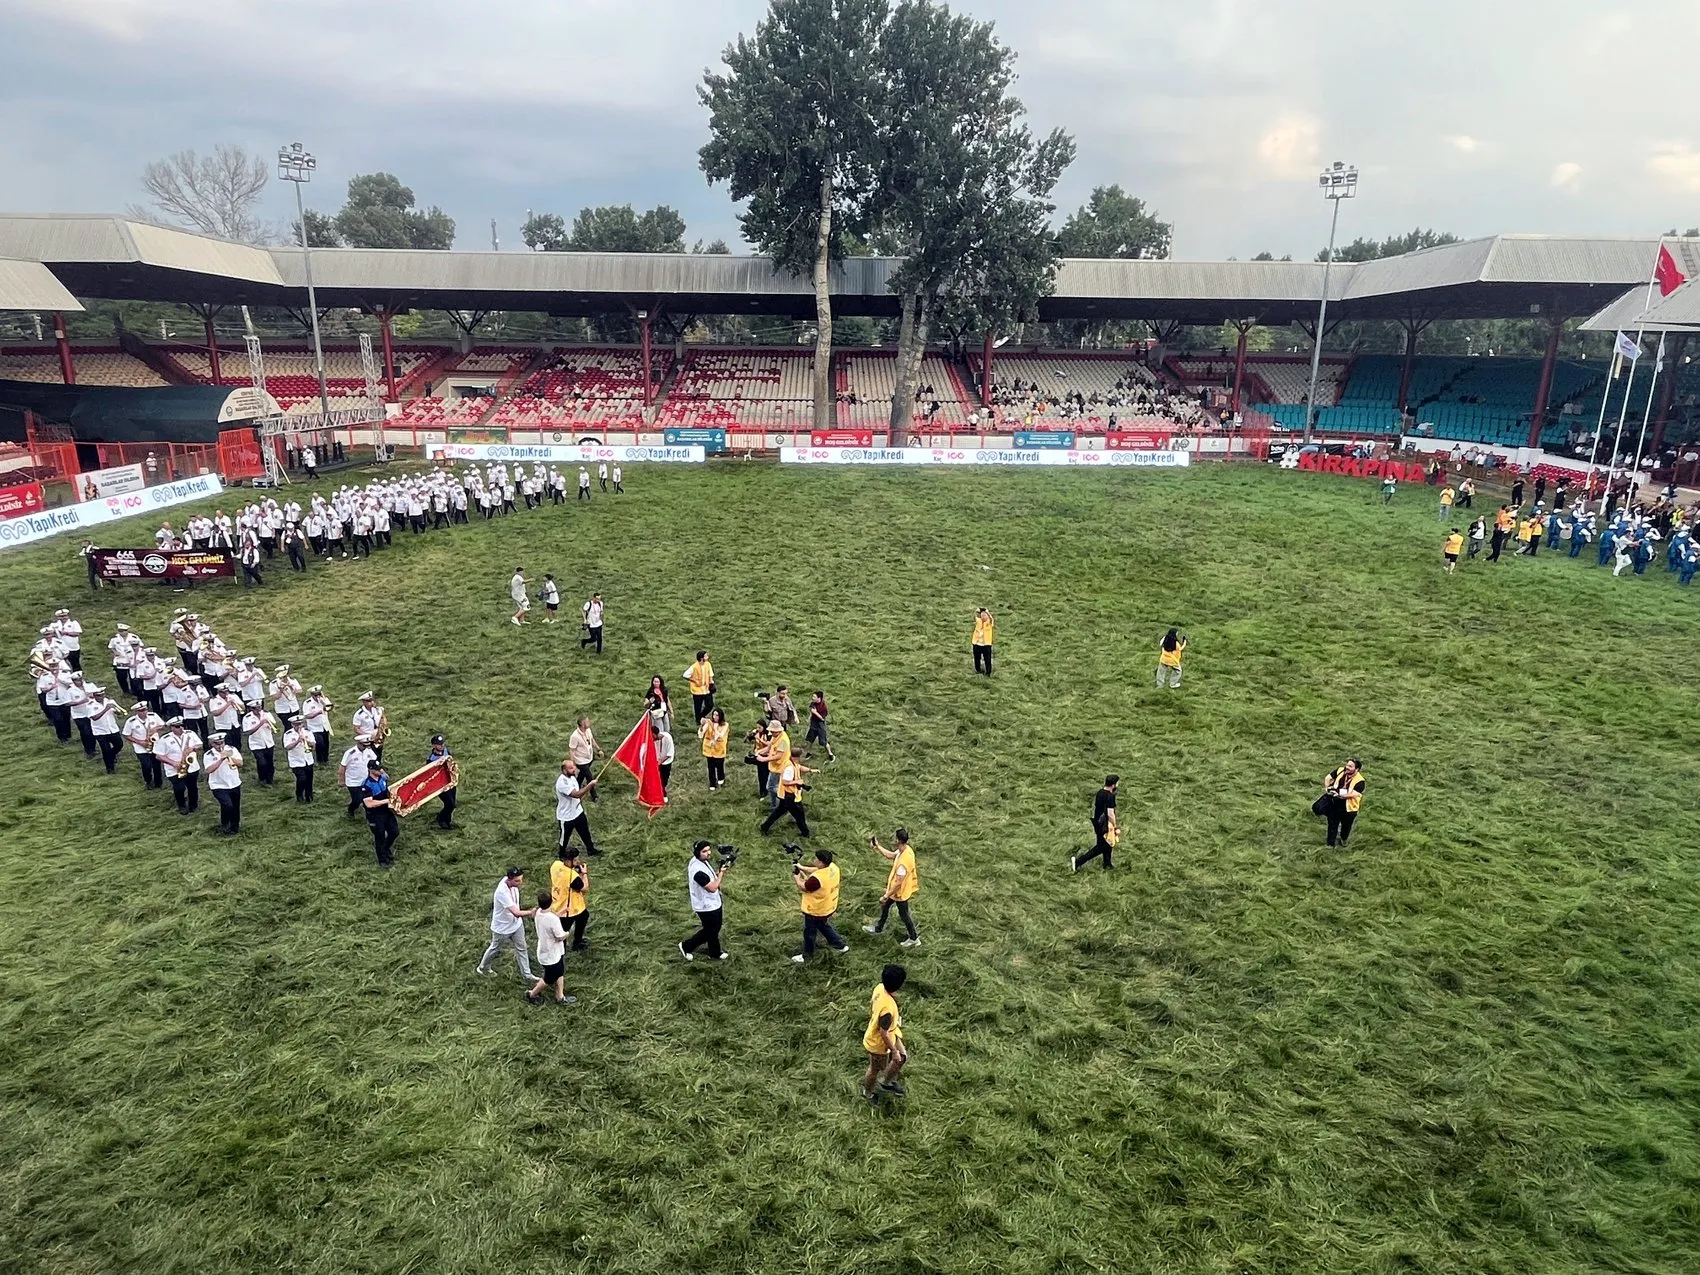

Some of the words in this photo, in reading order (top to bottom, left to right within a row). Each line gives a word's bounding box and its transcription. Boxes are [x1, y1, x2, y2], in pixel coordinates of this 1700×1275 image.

[510, 446, 552, 458] YapıKredi
[648, 448, 690, 458] YapıKredi
[863, 450, 904, 460] YapıKredi
[998, 452, 1039, 462] YapıKredi
[1134, 453, 1174, 463] YapıKredi
[170, 479, 209, 497] YapıKredi
[26, 508, 80, 532] YapıKredi
[116, 550, 135, 560] 665
